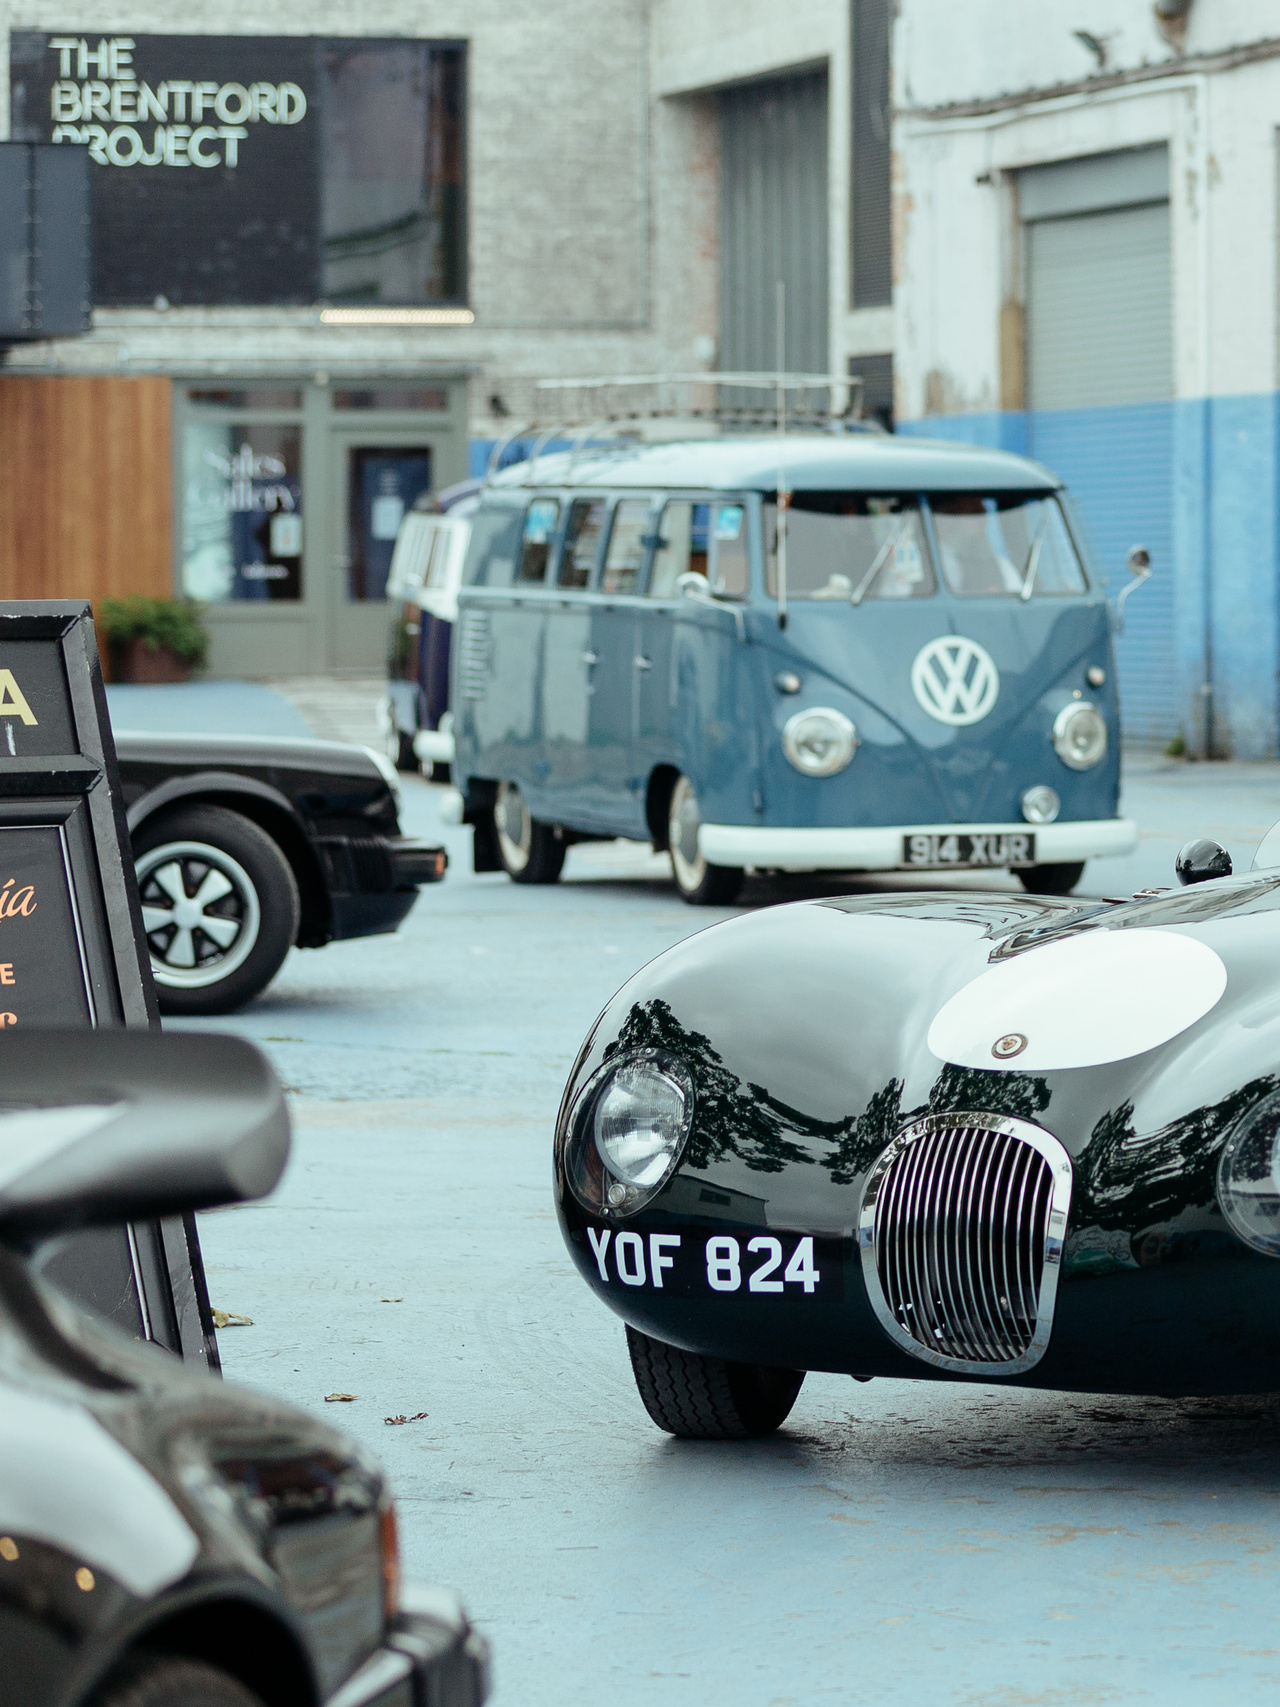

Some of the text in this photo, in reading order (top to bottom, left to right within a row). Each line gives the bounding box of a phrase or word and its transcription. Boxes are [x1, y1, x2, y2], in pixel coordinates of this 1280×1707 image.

[48, 37, 137, 80] THE
[51, 80, 307, 125] BRENTFORD
[911, 635, 999, 726] VW
[910, 833, 1030, 864] 914 XUR
[587, 1226, 821, 1294] YOF 824
